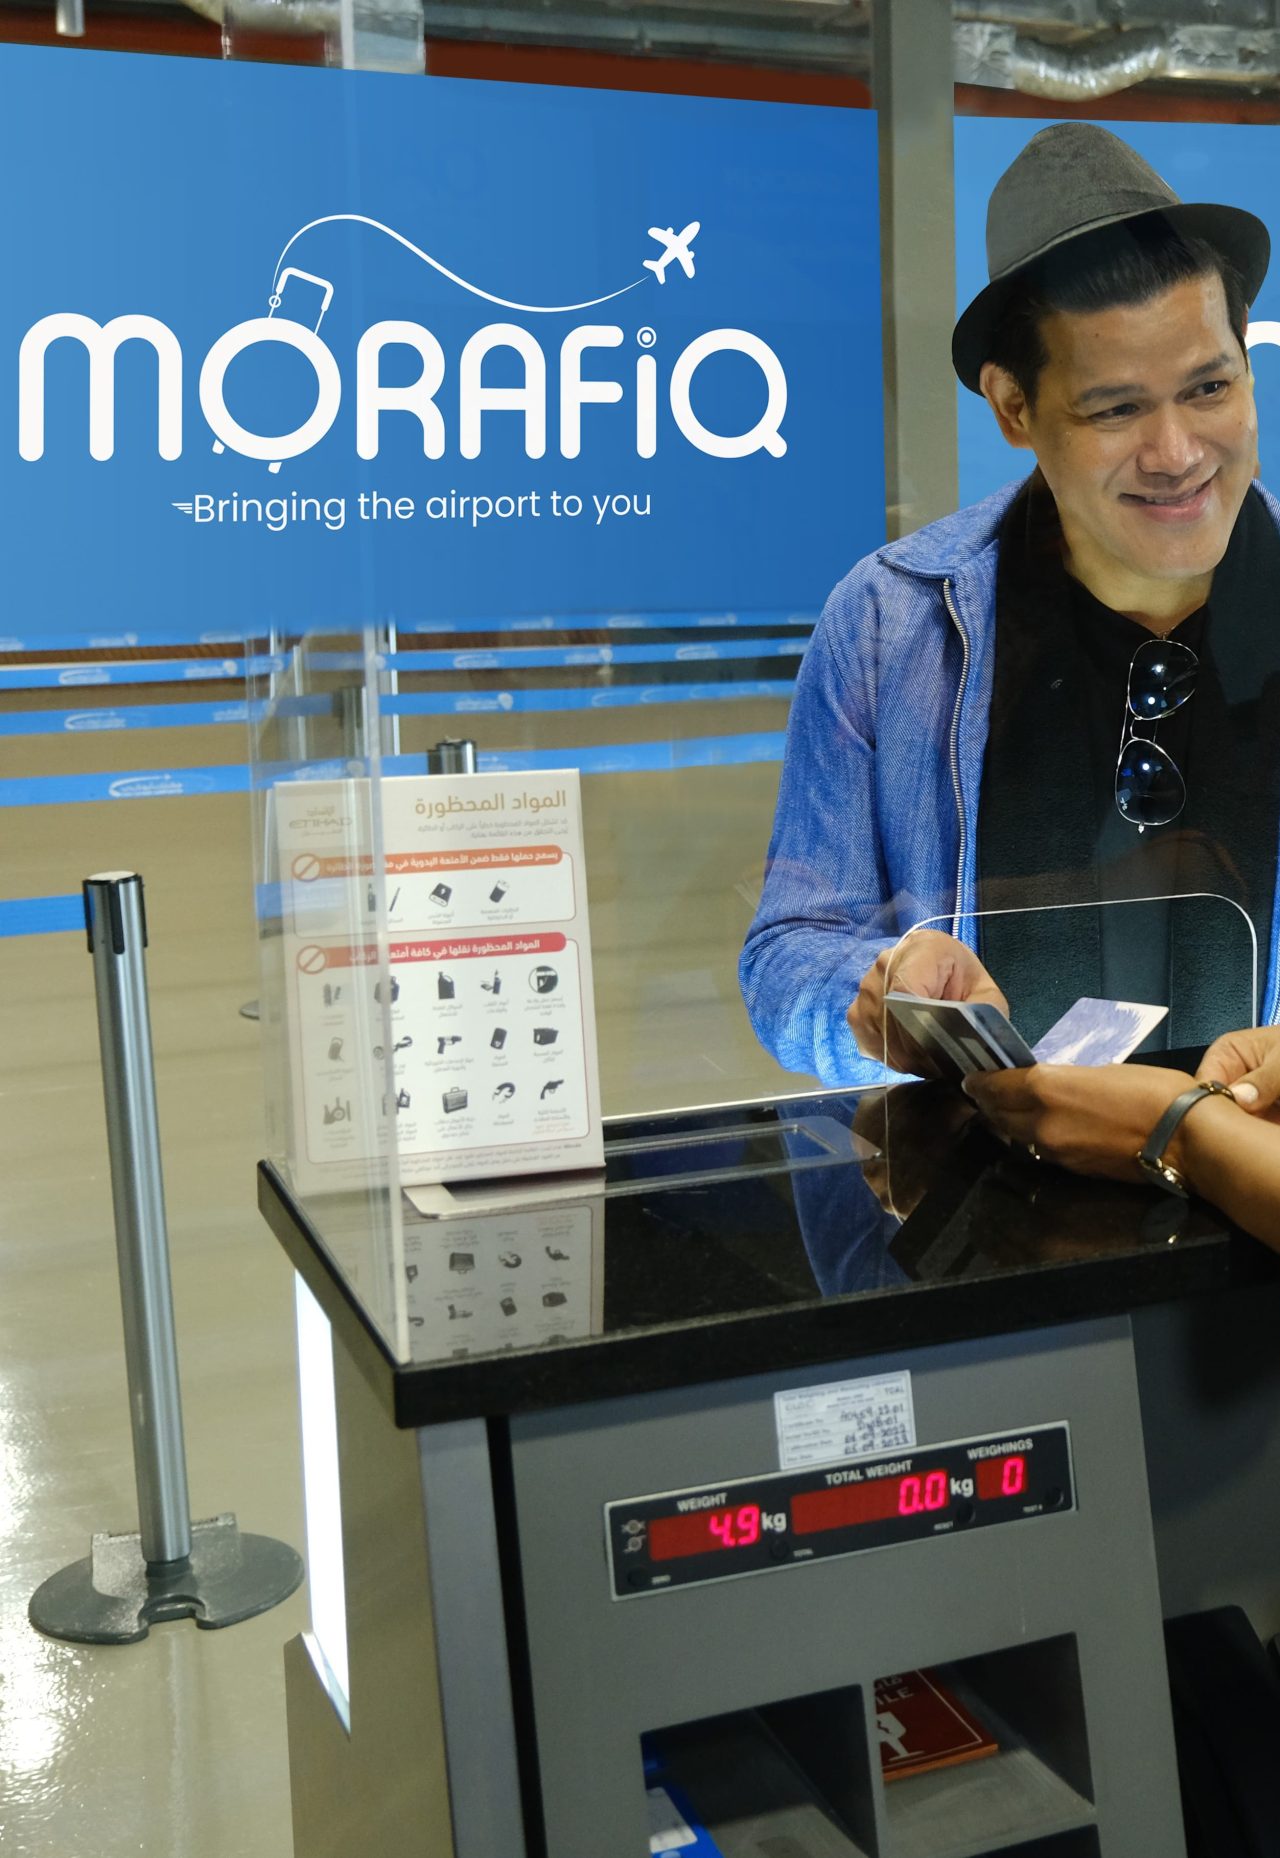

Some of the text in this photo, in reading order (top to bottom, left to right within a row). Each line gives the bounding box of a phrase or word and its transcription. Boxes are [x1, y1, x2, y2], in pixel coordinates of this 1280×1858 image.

[194, 489, 651, 531] Bringing the airport to you
[415, 790, 567, 819] المواد المحظورة
[515, 939, 541, 951] المواد
[967, 1438, 1034, 1460] WEIGHINGS
[825, 1459, 913, 1486] TOTAL WEIGHT
[1001, 1457, 1024, 1496] 0
[677, 1492, 728, 1513] WEIGHT
[898, 1470, 974, 1516] 0.0 kg
[761, 1512, 787, 1533] kg
